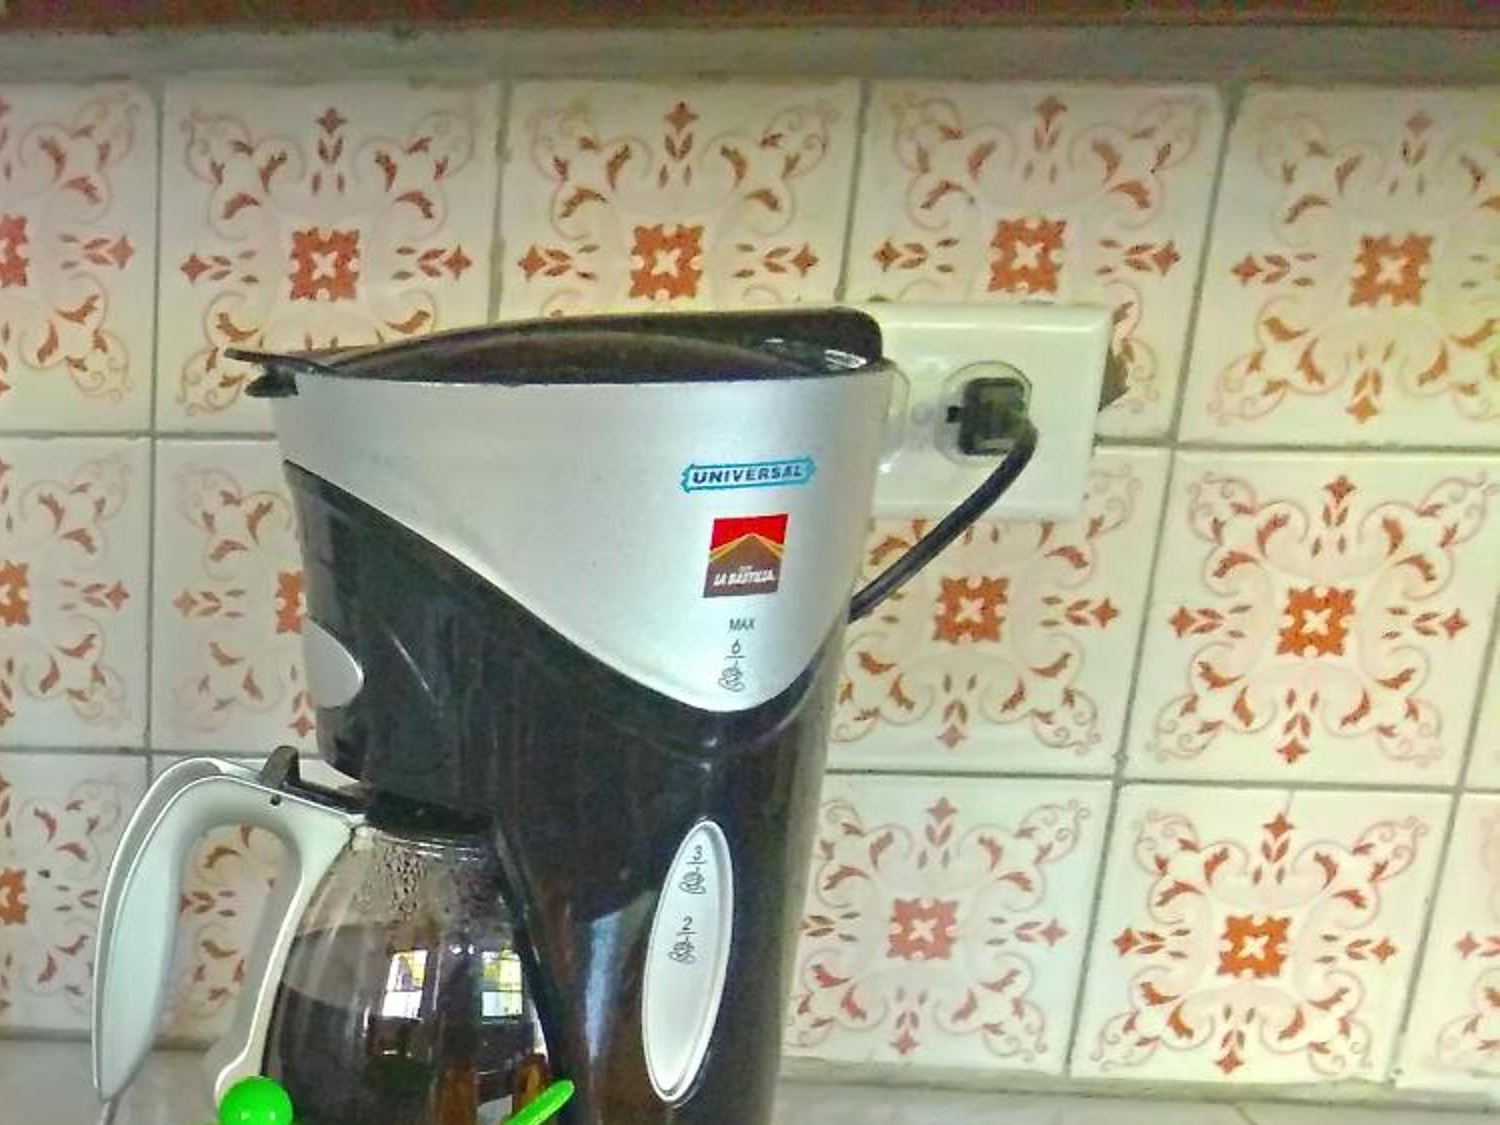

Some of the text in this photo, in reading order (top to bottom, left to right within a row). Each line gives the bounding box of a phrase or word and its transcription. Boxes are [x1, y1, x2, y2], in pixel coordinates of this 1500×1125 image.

[692, 463, 804, 485] UNIVERSAL
[729, 617, 756, 631] MAX
[731, 639, 741, 655] 6
[682, 915, 693, 931] 2
